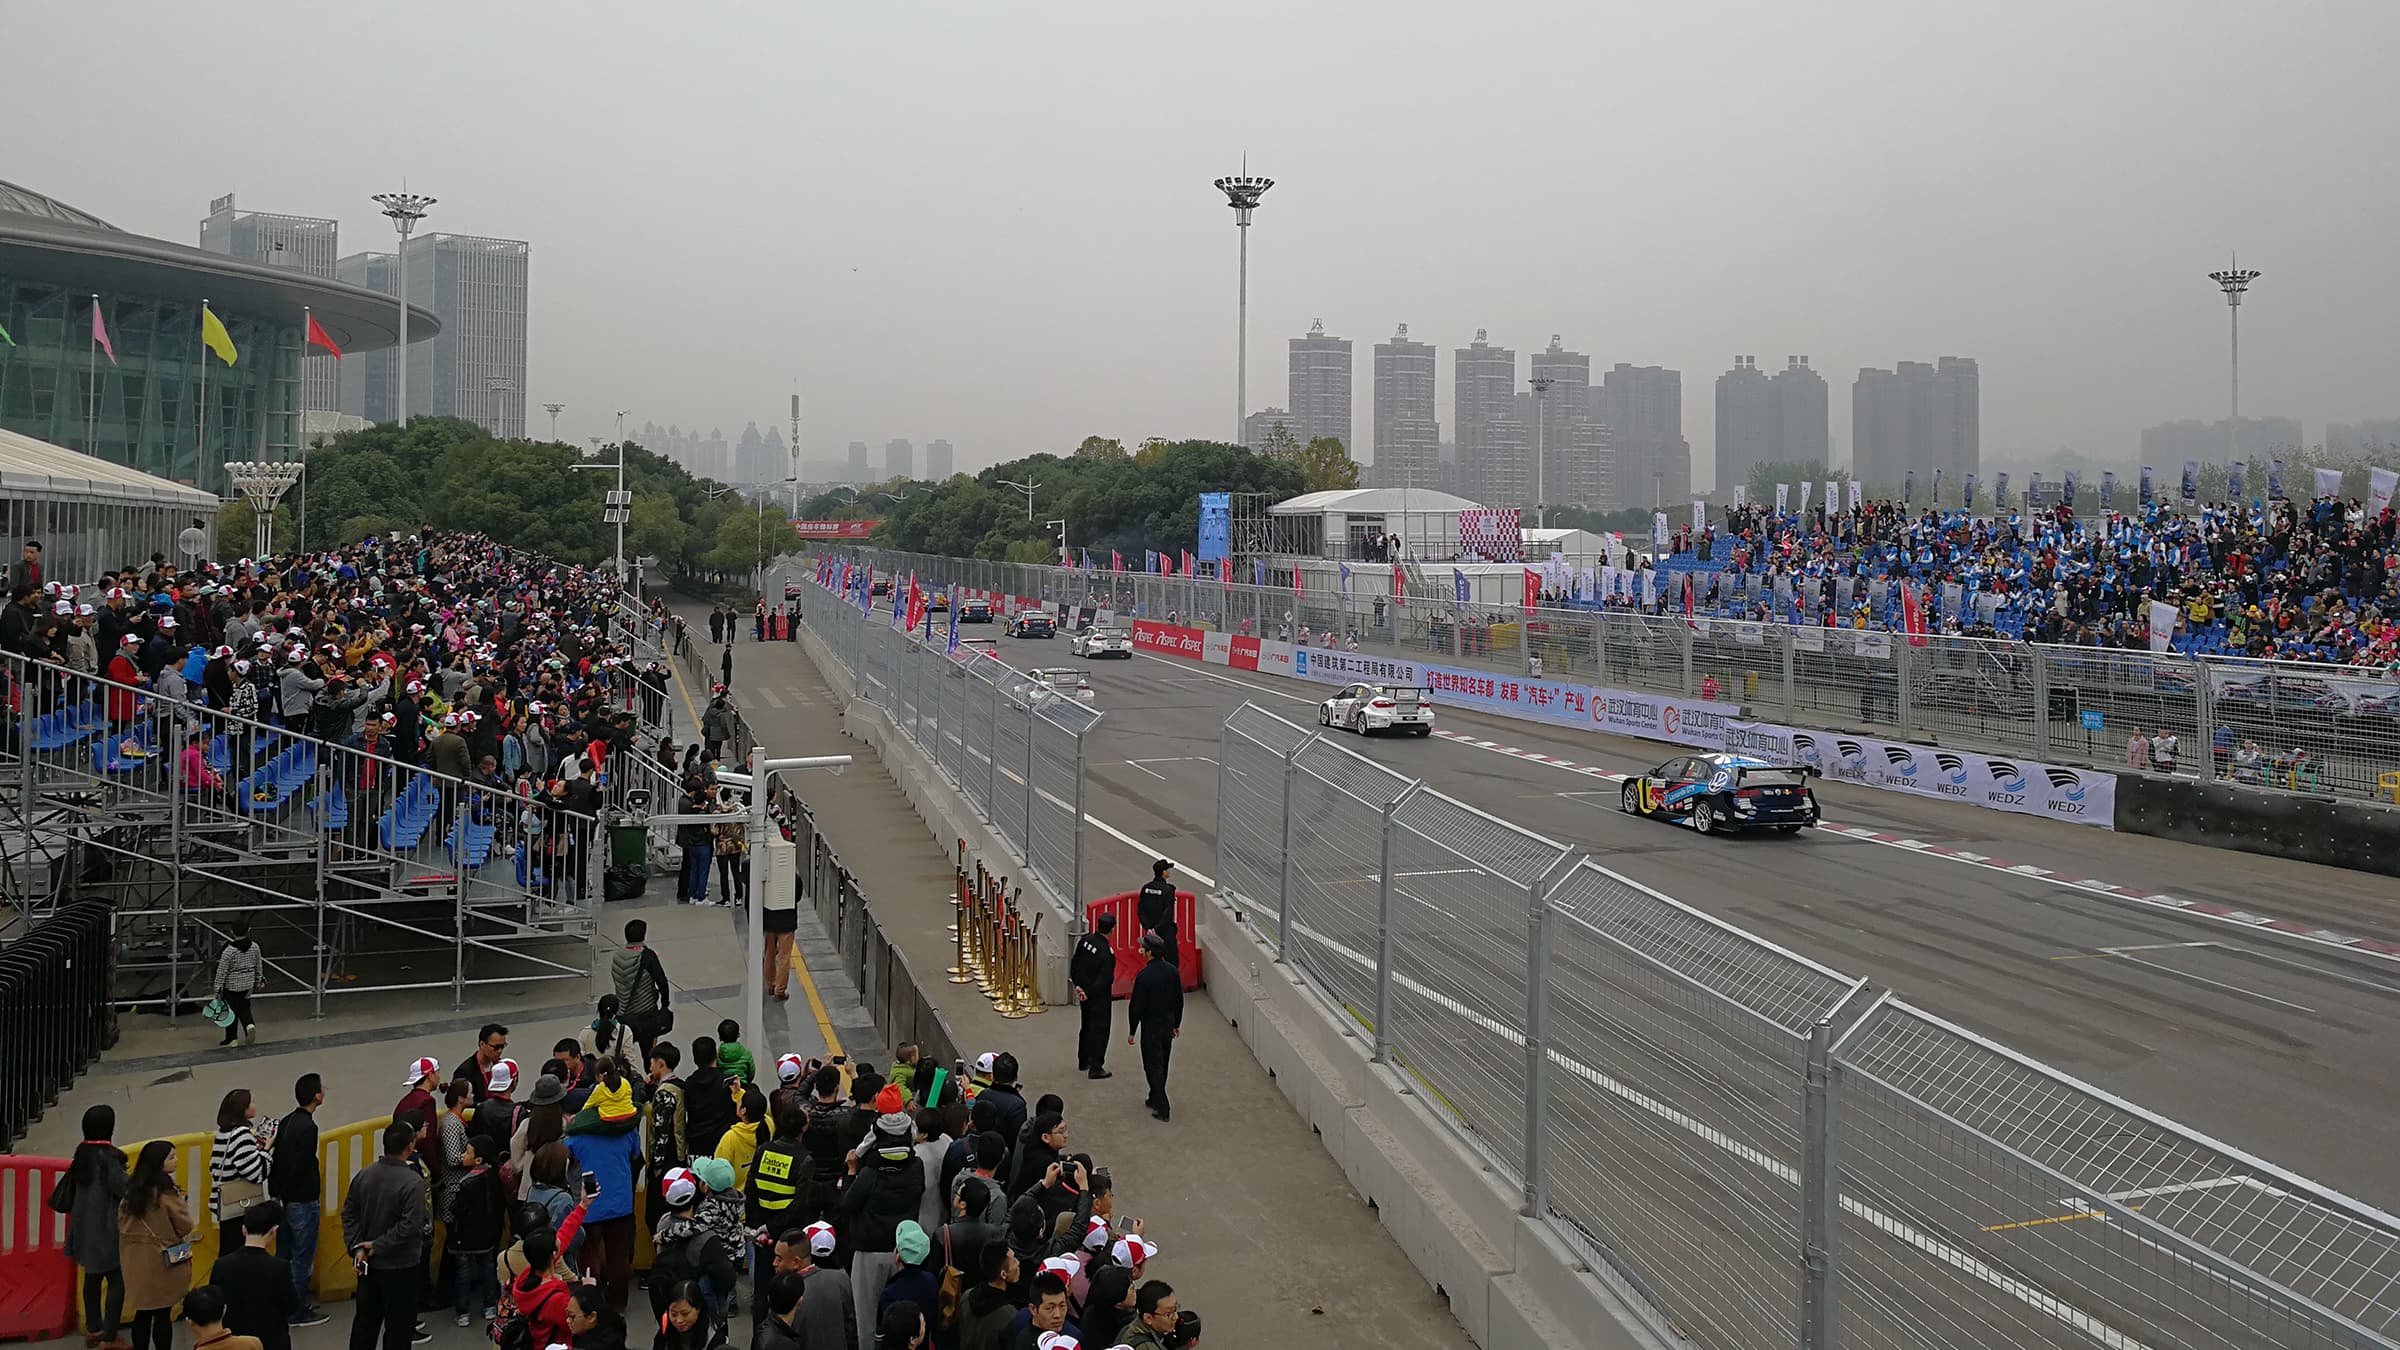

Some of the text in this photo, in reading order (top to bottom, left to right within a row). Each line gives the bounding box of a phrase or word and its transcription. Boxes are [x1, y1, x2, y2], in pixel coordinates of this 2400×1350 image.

[1310, 653, 1413, 682] 中国建筑第二工程局有限公司
[1426, 671, 1495, 698] 打造世界知名车都
[1500, 681, 1519, 702] 发展
[1564, 691, 1585, 713] 产业
[1608, 698, 1658, 722] 武汉体育中心
[1608, 715, 1658, 730] Wuhan Sports Center
[1682, 727, 1701, 737] Wuhan
[1701, 731, 1719, 740] Sports
[1725, 728, 1789, 755] 武汉体育中心
[1767, 755, 1788, 766] Center
[1838, 767, 1867, 779] WEDZ
[1885, 775, 1917, 788] WEDZ
[1936, 783, 1968, 797] WEDZ
[1987, 791, 2025, 806] WEDZ
[2047, 799, 2086, 815] WEDZ
